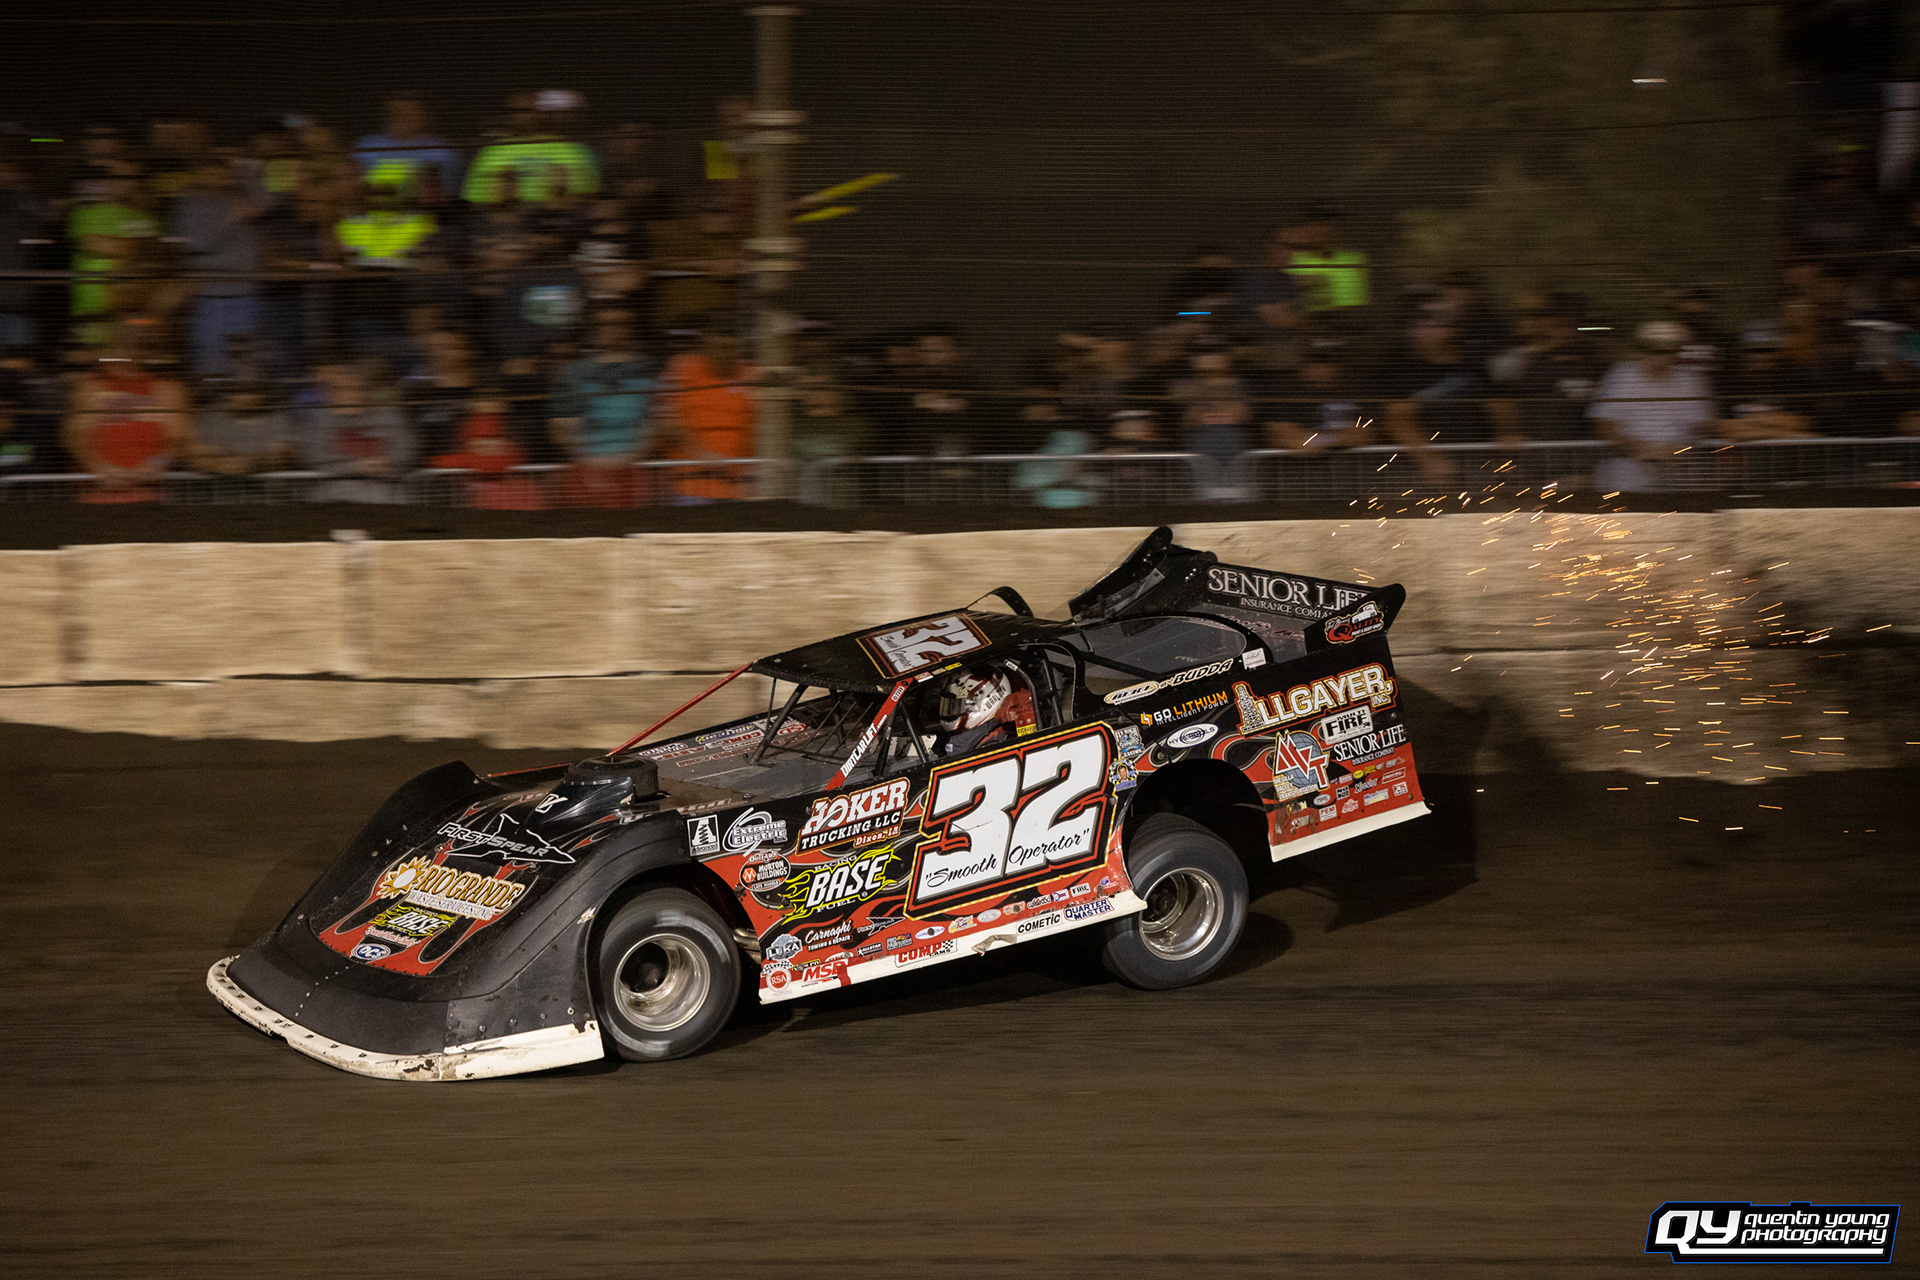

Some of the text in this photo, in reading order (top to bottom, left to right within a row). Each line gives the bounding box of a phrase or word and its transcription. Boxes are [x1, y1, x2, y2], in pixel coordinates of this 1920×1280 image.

[1207, 566, 1310, 606] SENIOR
[1240, 597, 1292, 614] INSURANCE
[1173, 658, 1234, 685] BUDDA
[1153, 708, 1172, 721] GO
[1173, 690, 1228, 715] LITHIUM
[1203, 699, 1229, 711] POWER
[1326, 713, 1368, 737] FIRE
[1333, 724, 1406, 762] SENIOR LIFE
[917, 734, 1104, 900] 32
[1320, 806, 1335, 815] PEM
[733, 820, 786, 836] Extreme
[734, 829, 787, 845] Electric
[801, 811, 901, 850] TRUCKING LLC
[855, 826, 899, 846] Dixon, IA
[758, 860, 784, 873] MORTON
[814, 855, 858, 871] RACING
[757, 866, 788, 881] BUILDINGS
[806, 854, 892, 908] BASE
[414, 866, 525, 910] RIO GRANDE
[1065, 900, 1107, 918] QUARTER
[1074, 904, 1111, 921] MASTER
[387, 911, 449, 934] BASE
[805, 920, 852, 944] Carnaghi
[808, 941, 828, 951] TOWING
[832, 934, 851, 945] REPAIR
[898, 941, 942, 963] COMP
[770, 974, 787, 985] RSA
